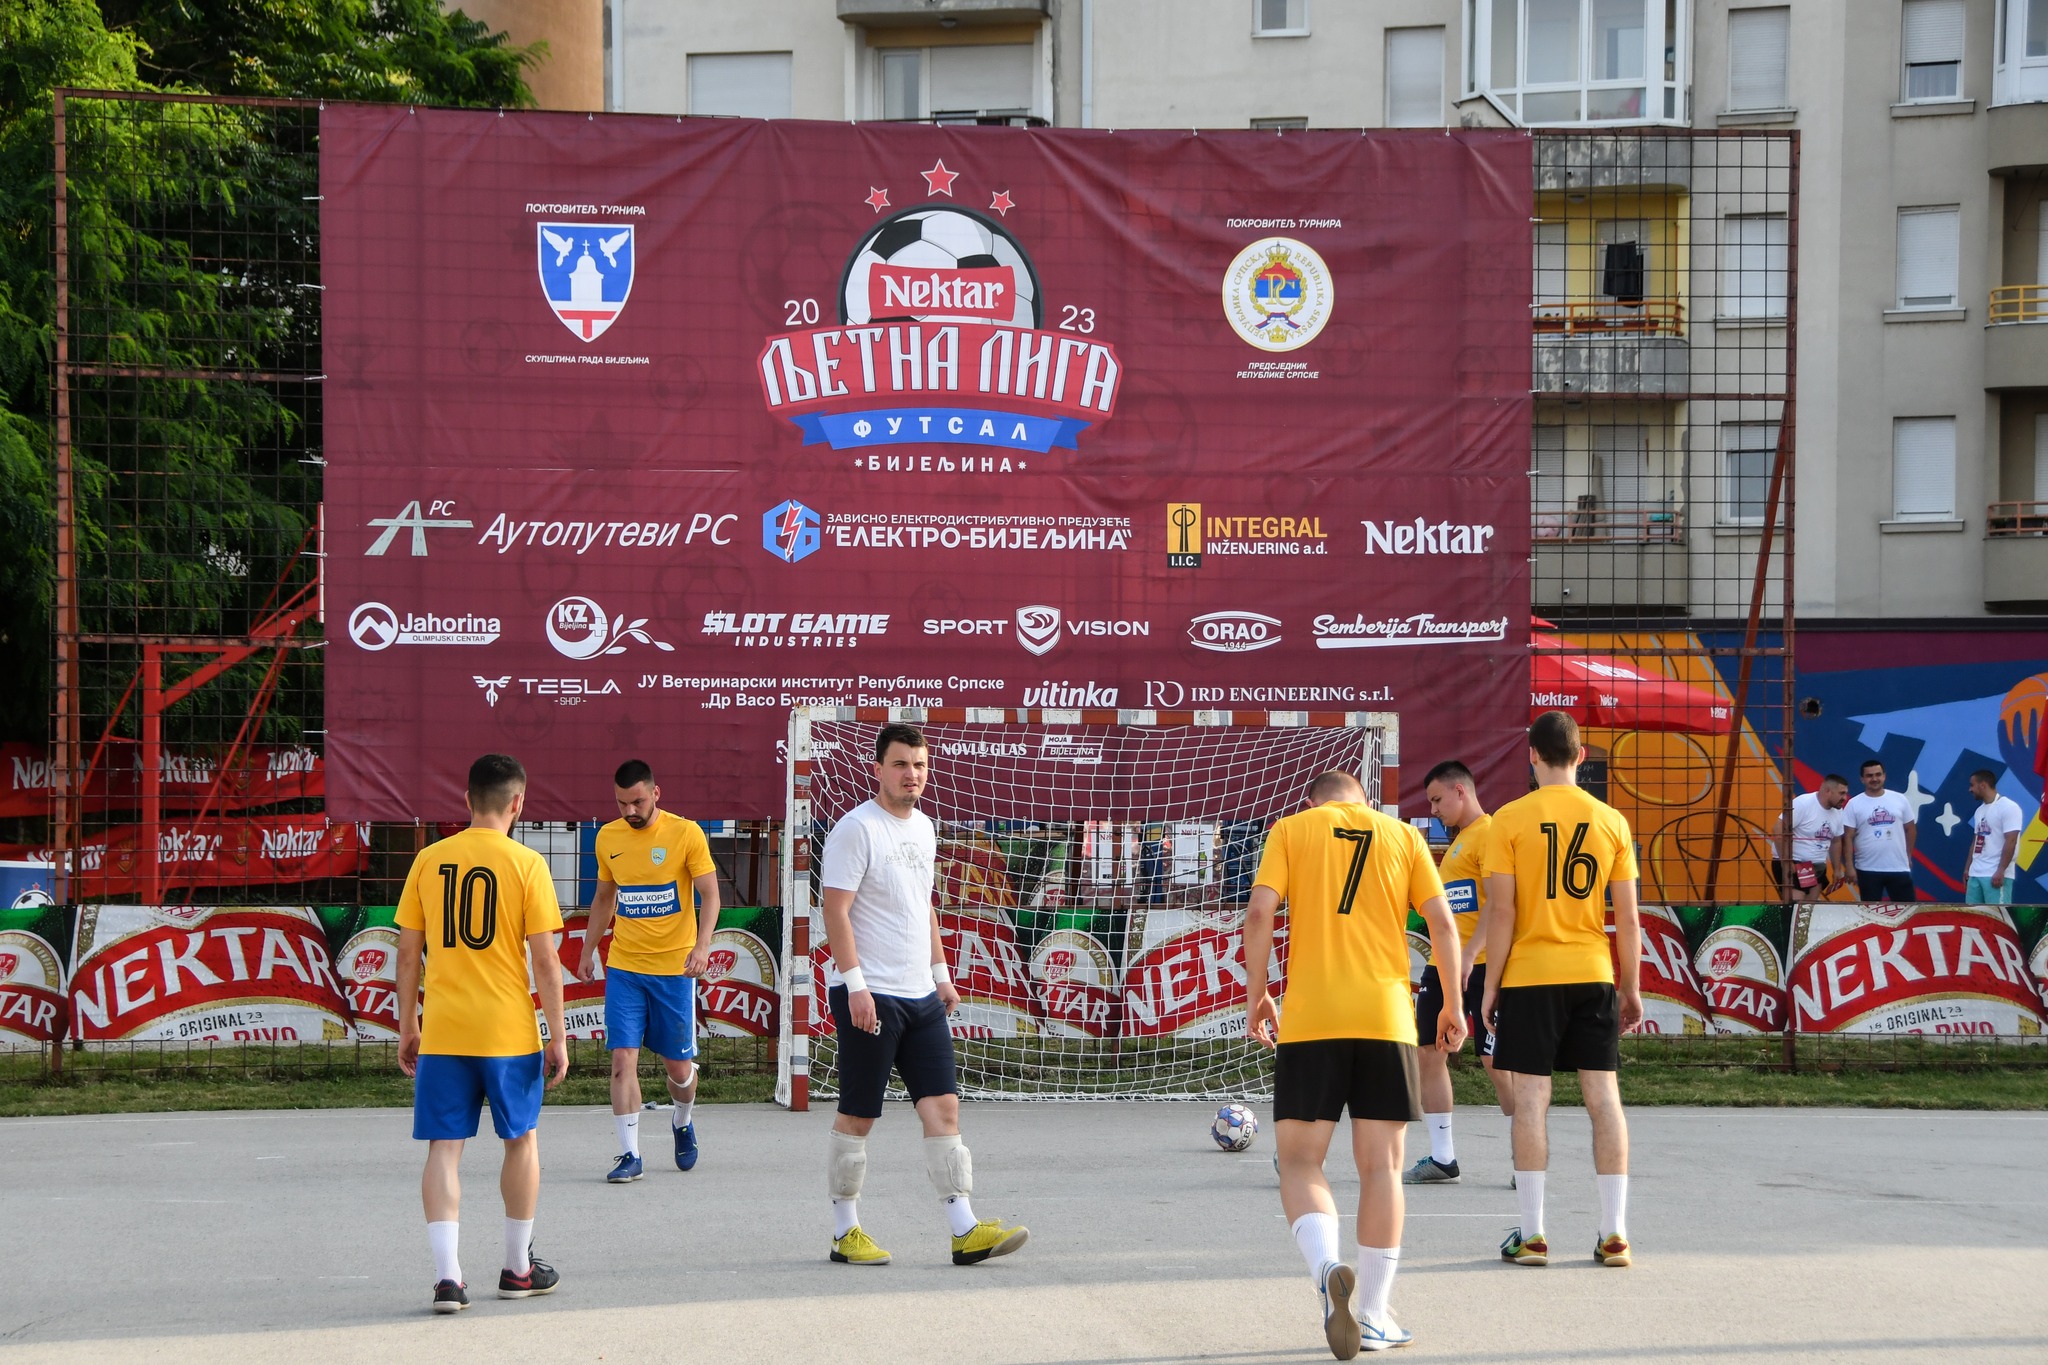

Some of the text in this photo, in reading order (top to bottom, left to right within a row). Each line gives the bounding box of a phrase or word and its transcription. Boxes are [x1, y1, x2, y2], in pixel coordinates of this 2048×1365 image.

[600, 205, 646, 215] ТУРНИРА
[1226, 219, 1342, 229] ПОКРОВИТЕЉ ТУРНИРА
[881, 272, 1004, 309] Nektar
[784, 299, 820, 326] 20
[1059, 305, 1096, 333] 23
[525, 355, 650, 365] СКУПШТИНА ГРАДА БИЈЕЉИНА
[761, 326, 1119, 412] ЉЕТНА ЛИГА
[1248, 362, 1308, 371] ПРЕДСЈЕДНИК
[1236, 371, 1320, 379] РЕПУБЛИКЕ СРПСКЕ
[853, 416, 1027, 441] ФУТСАЛ
[868, 455, 1013, 473] БИЈЕЉИНА
[827, 513, 1131, 527] ЗАВИСНО ЕЛЕКТРОДИСТРИБУТИВНО ПРЕДУЗЕЋЕ
[1207, 516, 1328, 538] INTEGRAL
[478, 513, 681, 555] Аутопутеви
[1361, 516, 1494, 555] Nektar
[1206, 538, 1328, 555] INŽENJERING a.d.
[1171, 556, 1197, 567] I.I.C.
[558, 604, 588, 622] KZ
[400, 612, 501, 633] Jahorina
[559, 622, 587, 630] Bijeljina
[790, 613, 891, 634] GAME
[923, 619, 1150, 636] SPORT VISION
[1202, 622, 1267, 640] ORAO
[1312, 613, 1508, 640] Semberija Transport
[412, 635, 486, 643] OLIMPIJSKI CENTAR
[735, 636, 858, 648] INDUSTRIES
[1224, 642, 1247, 651] 1944
[519, 678, 622, 695] TESLA
[637, 675, 1005, 693] ЈУ Ветеринарски институт Републике Српске
[736, 693, 778, 708] Васо
[857, 693, 901, 709] Бања
[905, 694, 944, 708] Лука
[1022, 680, 1119, 708] vitinka
[1191, 685, 1395, 703] IRD ENGINEERING s.r.l.
[1531, 691, 1578, 707] Nektar
[941, 742, 1028, 756] NOVI GLAS
[1050, 747, 1094, 756] BIJELJINA
[260, 824, 325, 859] Nektar
[1540, 822, 1598, 901] 16
[1333, 827, 1373, 915] 7
[623, 892, 673, 903] LUKA KOPER
[438, 863, 498, 951] 10
[625, 904, 674, 915] Port of Koper
[75, 927, 348, 1040] NEKTAR
[1793, 925, 2037, 1031] NEKTAR
[179, 1012, 246, 1037] ORIGINAL
[247, 1011, 263, 1020] 73
[1886, 1006, 1947, 1031] ORIGINAL
[1948, 1006, 1962, 1014] 73
